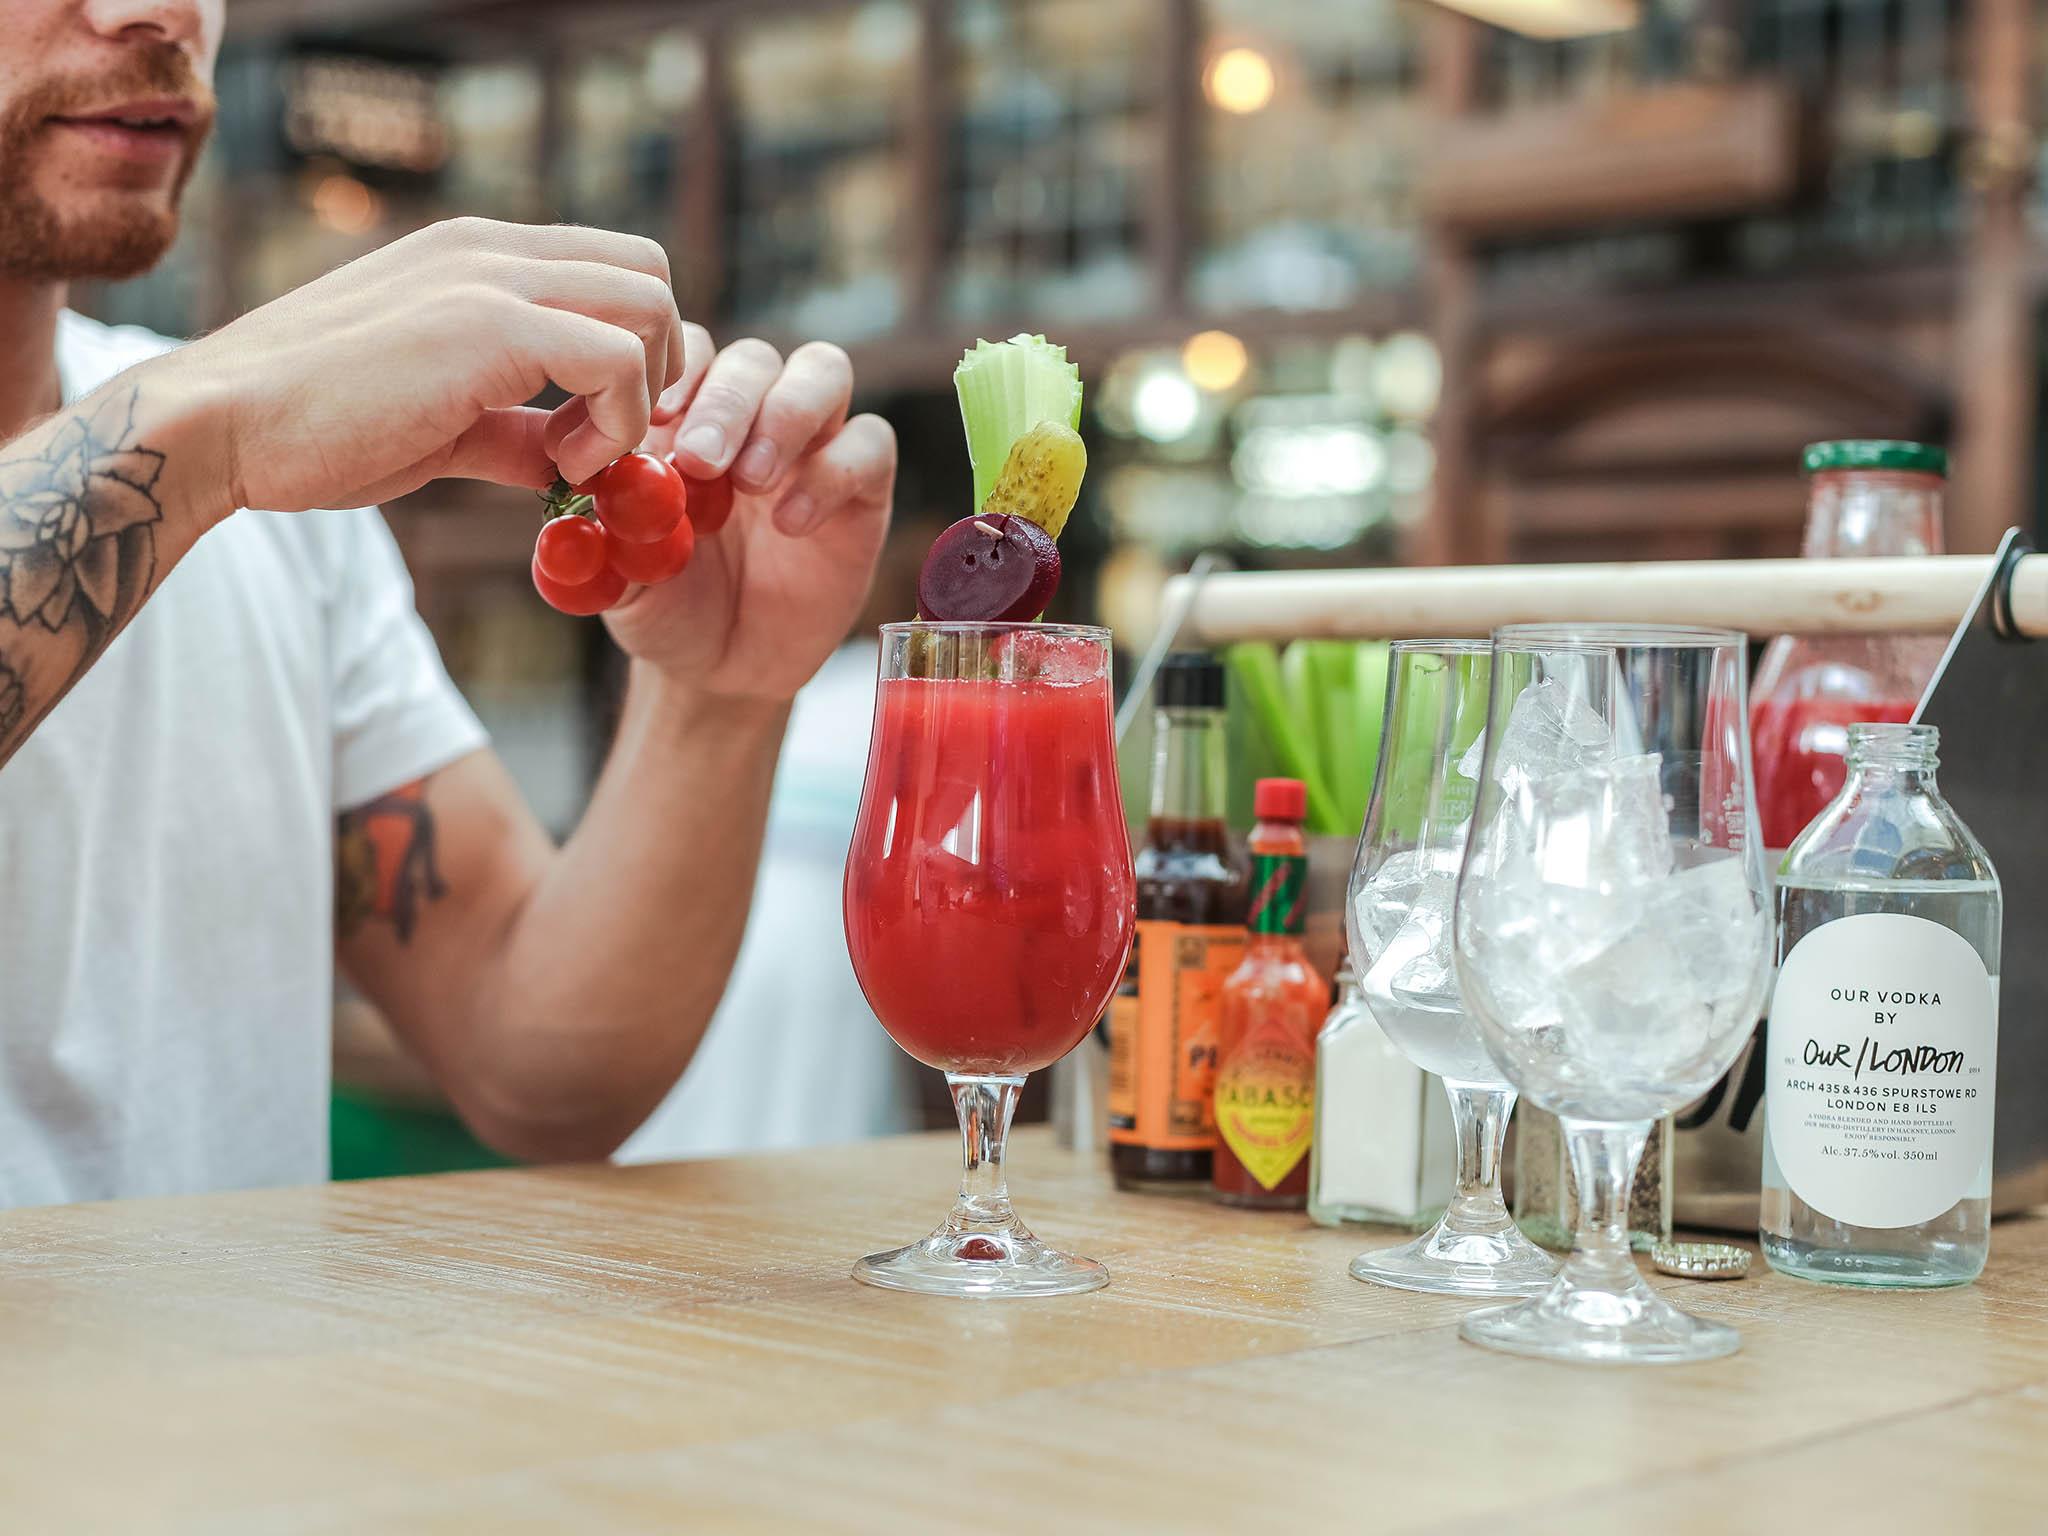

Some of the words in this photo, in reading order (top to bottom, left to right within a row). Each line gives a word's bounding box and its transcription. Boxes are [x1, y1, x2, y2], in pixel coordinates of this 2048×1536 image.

[1831, 988, 1869, 1003] OUR
[1877, 991, 1942, 1005] VODKA
[1874, 1012, 1897, 1024] BY
[1786, 1079, 1815, 1092] ARCH
[1882, 1087, 1962, 1099] SPURSTOWE
[1964, 1088, 1977, 1100] RD
[1827, 1098, 1887, 1112] LONDON
[1893, 1102, 1910, 1113] E8
[1814, 1113, 1836, 1121] VODKA
[1837, 1115, 1872, 1123] BLENDED
[1818, 1122, 1886, 1134] MICRO-DISTILLERY
[1844, 1132, 1868, 1140] ENJOY
[1868, 1134, 1917, 1142] RESPONSIBLY
[1822, 1145, 1842, 1157] Alc.
[1843, 1147, 1880, 1159] 37.5%
[1880, 1150, 1900, 1160] vol.
